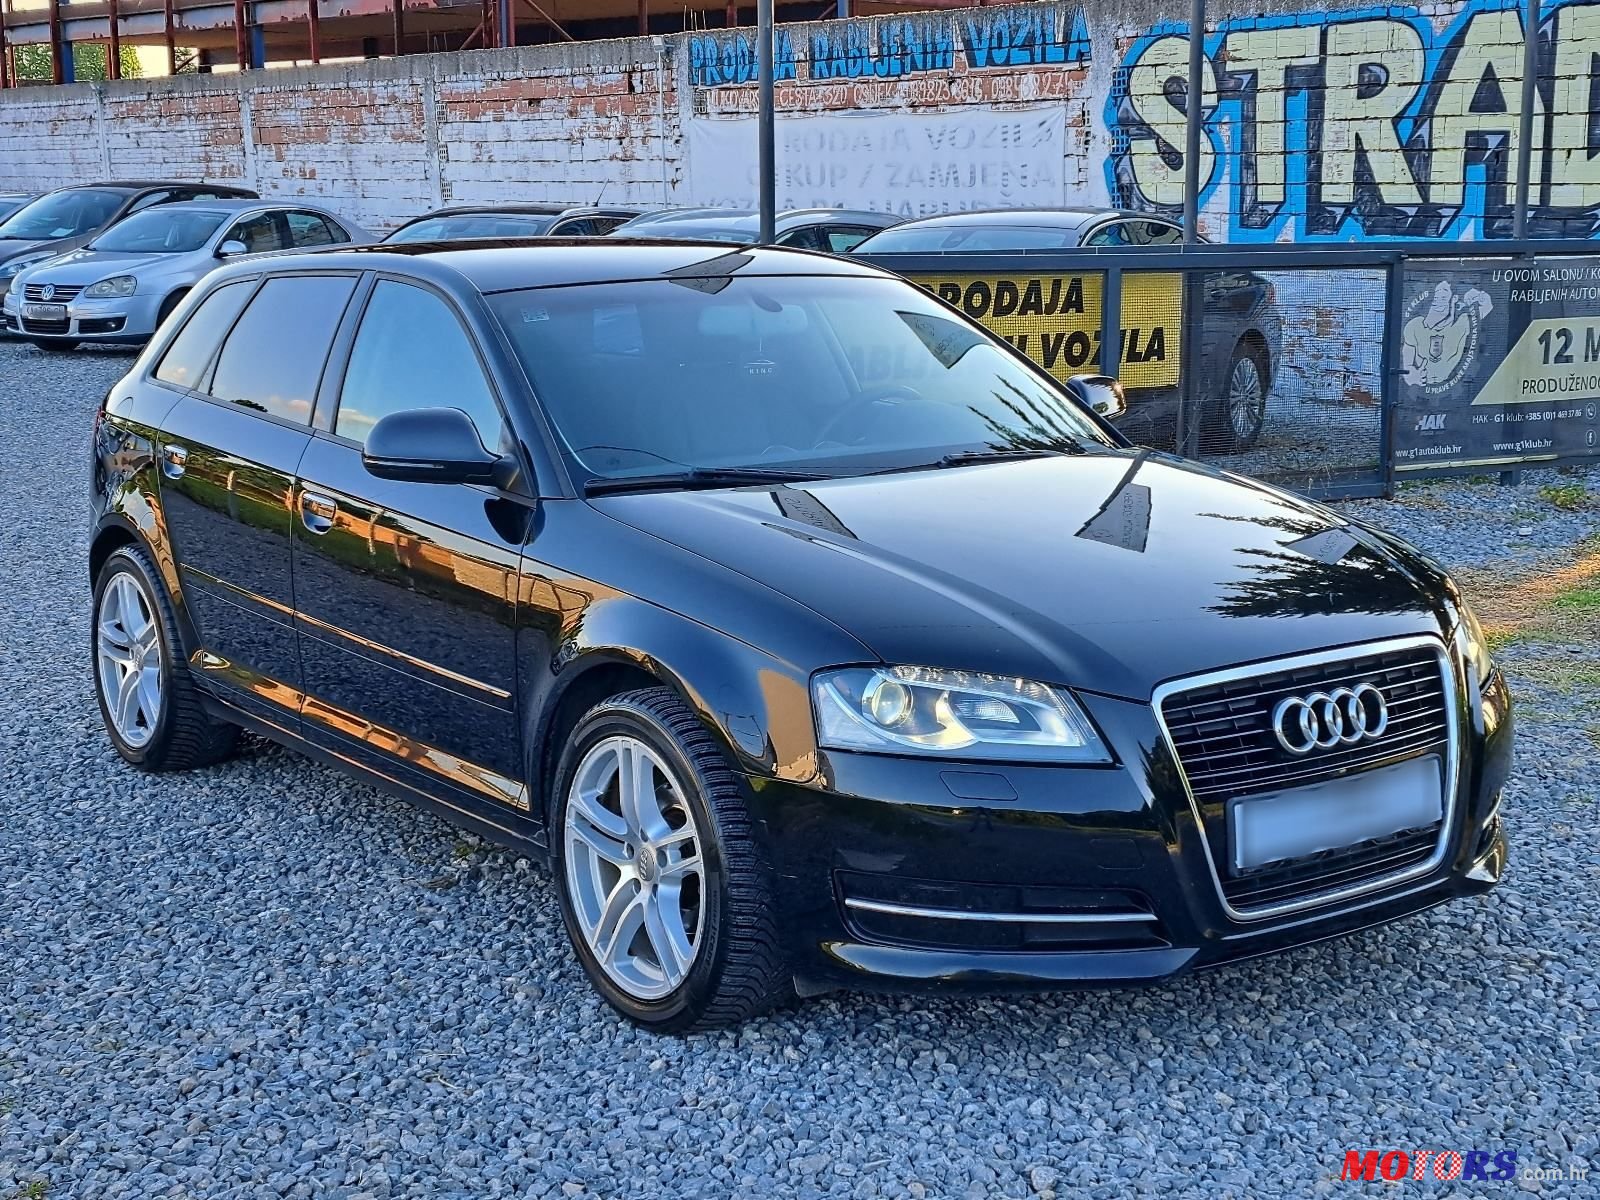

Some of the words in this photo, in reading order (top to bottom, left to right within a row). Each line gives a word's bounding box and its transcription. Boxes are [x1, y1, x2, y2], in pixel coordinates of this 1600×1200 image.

[967, 6, 1091, 67] VOZILA
[784, 127, 911, 152] RODAJA
[747, 161, 848, 188] OKUP
[1492, 269, 1502, 283] U
[1504, 269, 1540, 282] OVOM
[1543, 268, 1584, 281] SALONU
[918, 278, 1084, 319] RODAJA
[1511, 287, 1568, 304] RABLJENIH
[1538, 327, 1574, 365] 12
[1494, 413, 1505, 423] G1
[1395, 444, 1462, 459] ww.g1autoklub.hr
[1493, 439, 1553, 454] www.g1klub.hr
